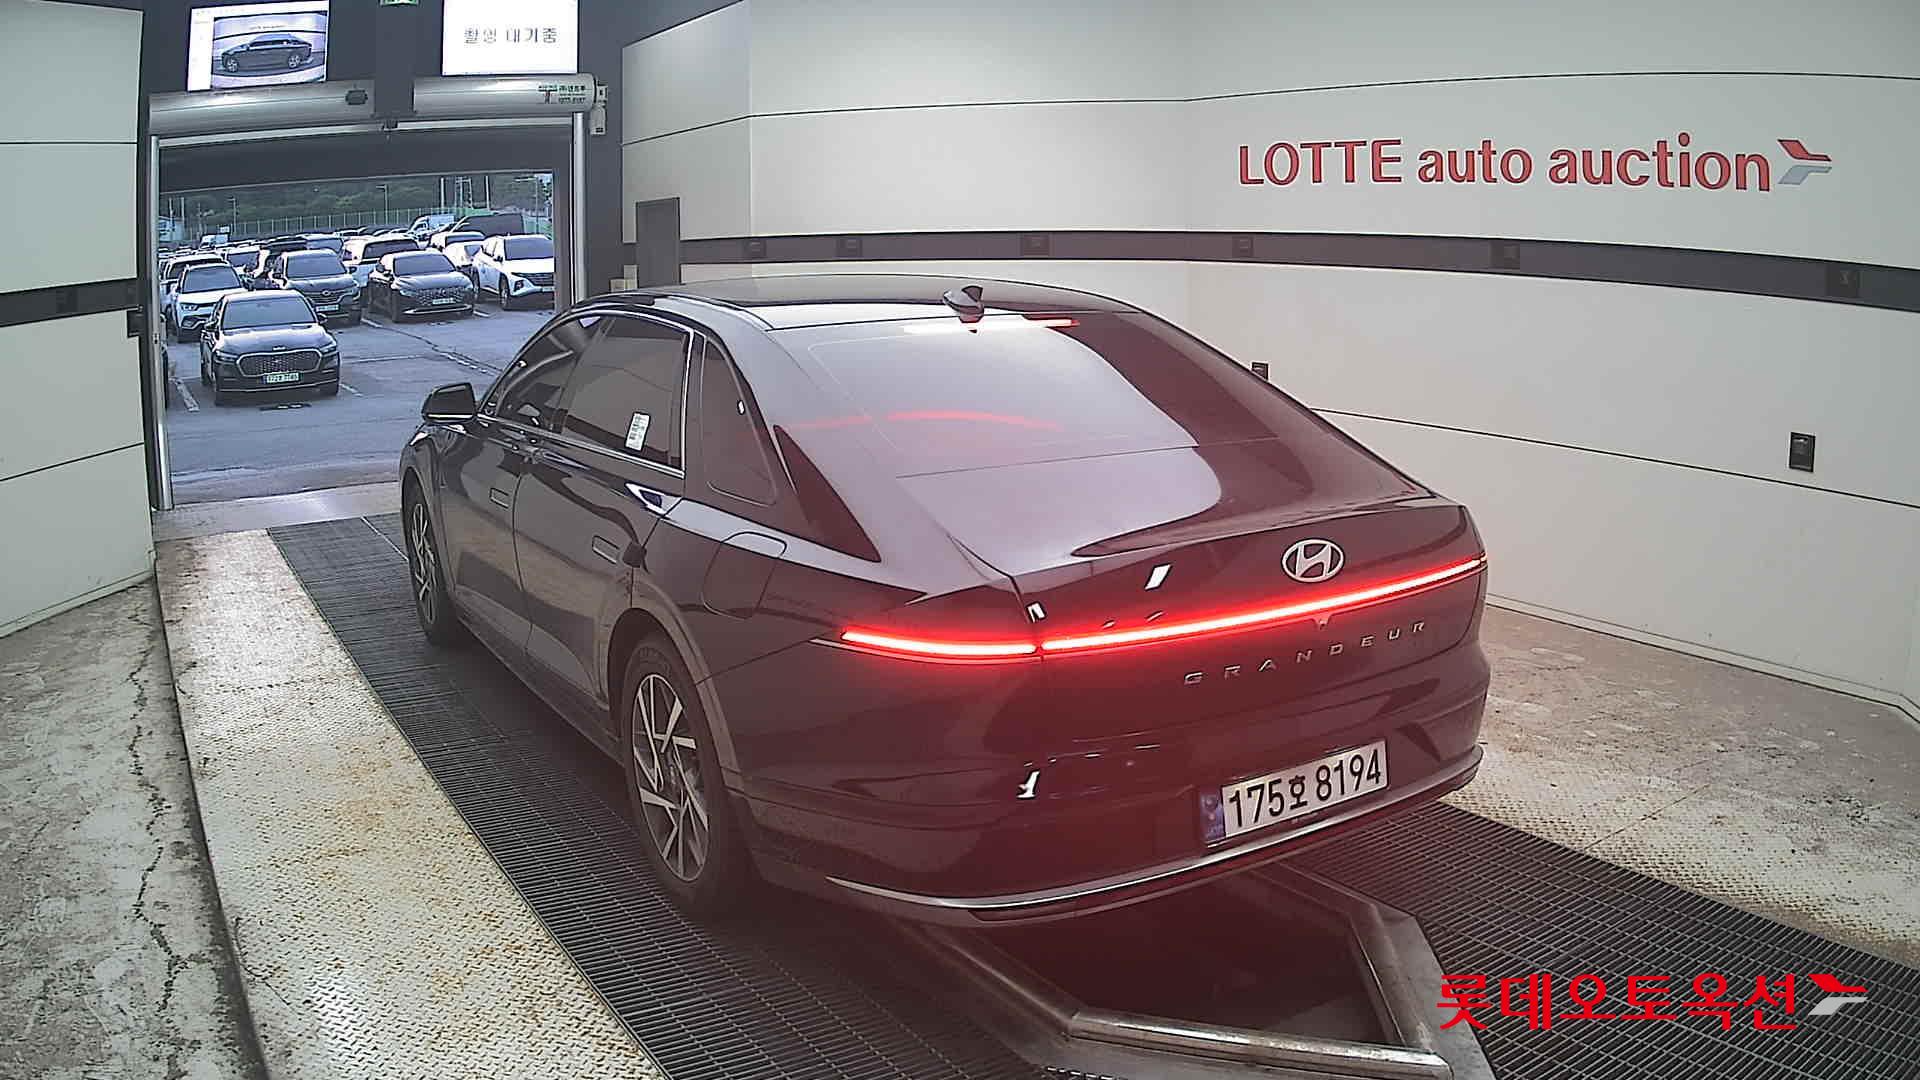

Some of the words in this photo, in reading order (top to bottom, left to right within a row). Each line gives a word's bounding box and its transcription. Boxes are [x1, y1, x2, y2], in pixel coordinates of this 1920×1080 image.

[506, 27, 557, 44] 대기중
[1239, 138, 1402, 186] LOTTE
[1417, 140, 1533, 184] auto
[1547, 131, 1771, 192] auction
[1184, 620, 1426, 686] GRANDEUR
[1228, 774, 1308, 828] 175호
[1316, 748, 1382, 802] 8194
